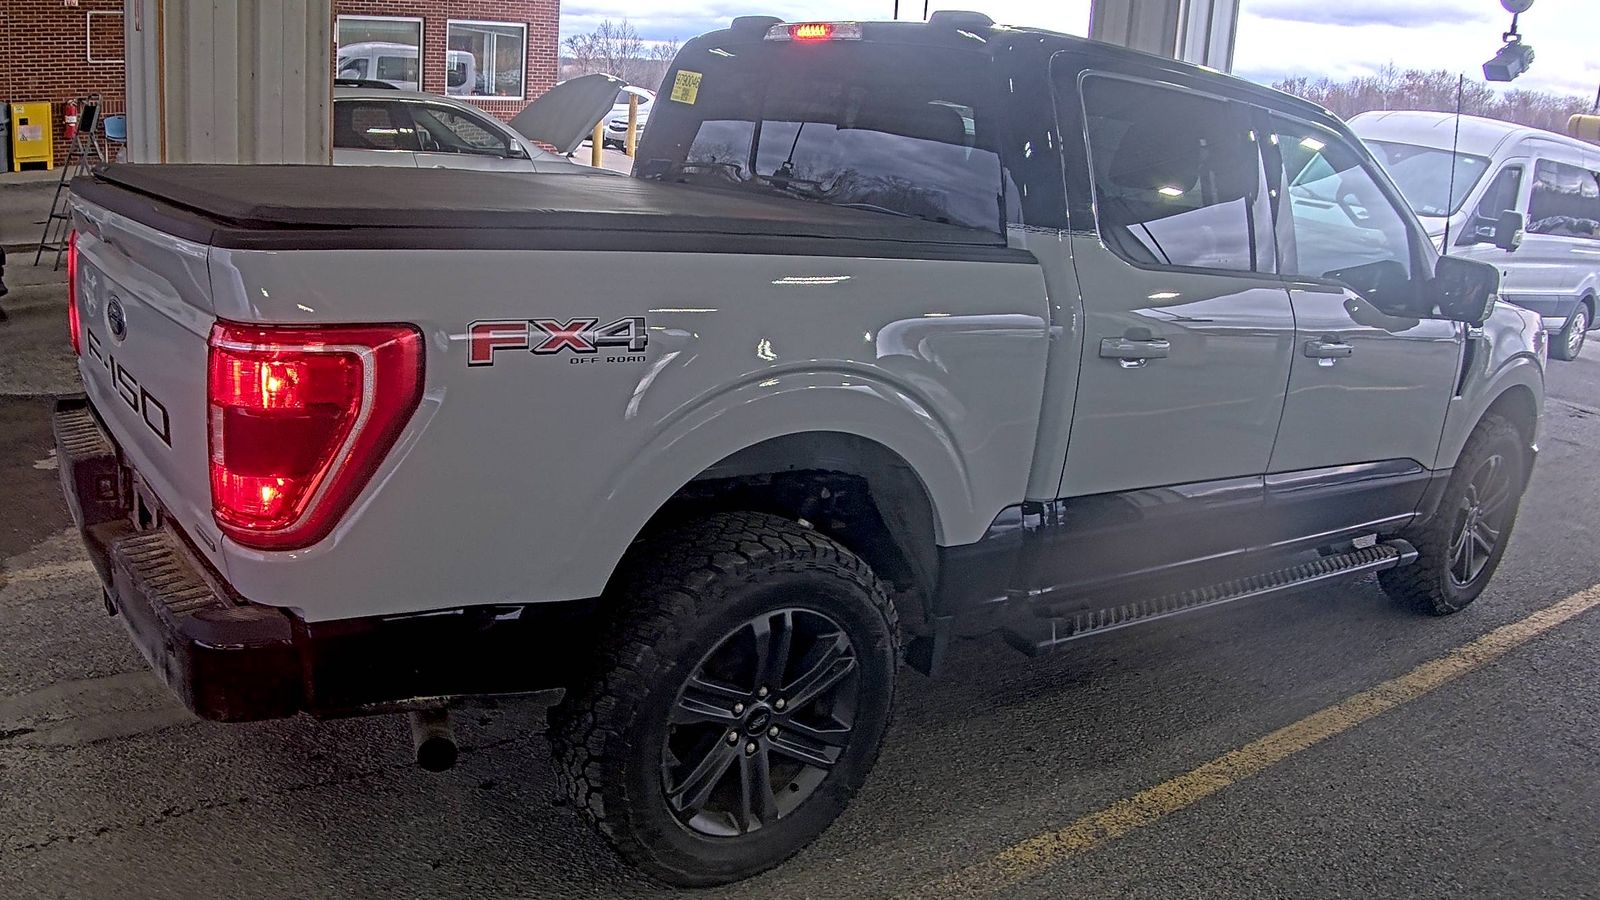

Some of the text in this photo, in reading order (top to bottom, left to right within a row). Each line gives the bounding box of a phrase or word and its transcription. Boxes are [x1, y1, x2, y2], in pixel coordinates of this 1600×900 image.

[468, 317, 648, 367] FX4
[569, 355, 646, 364] OFF ROAD
[88, 328, 172, 448] F-150
